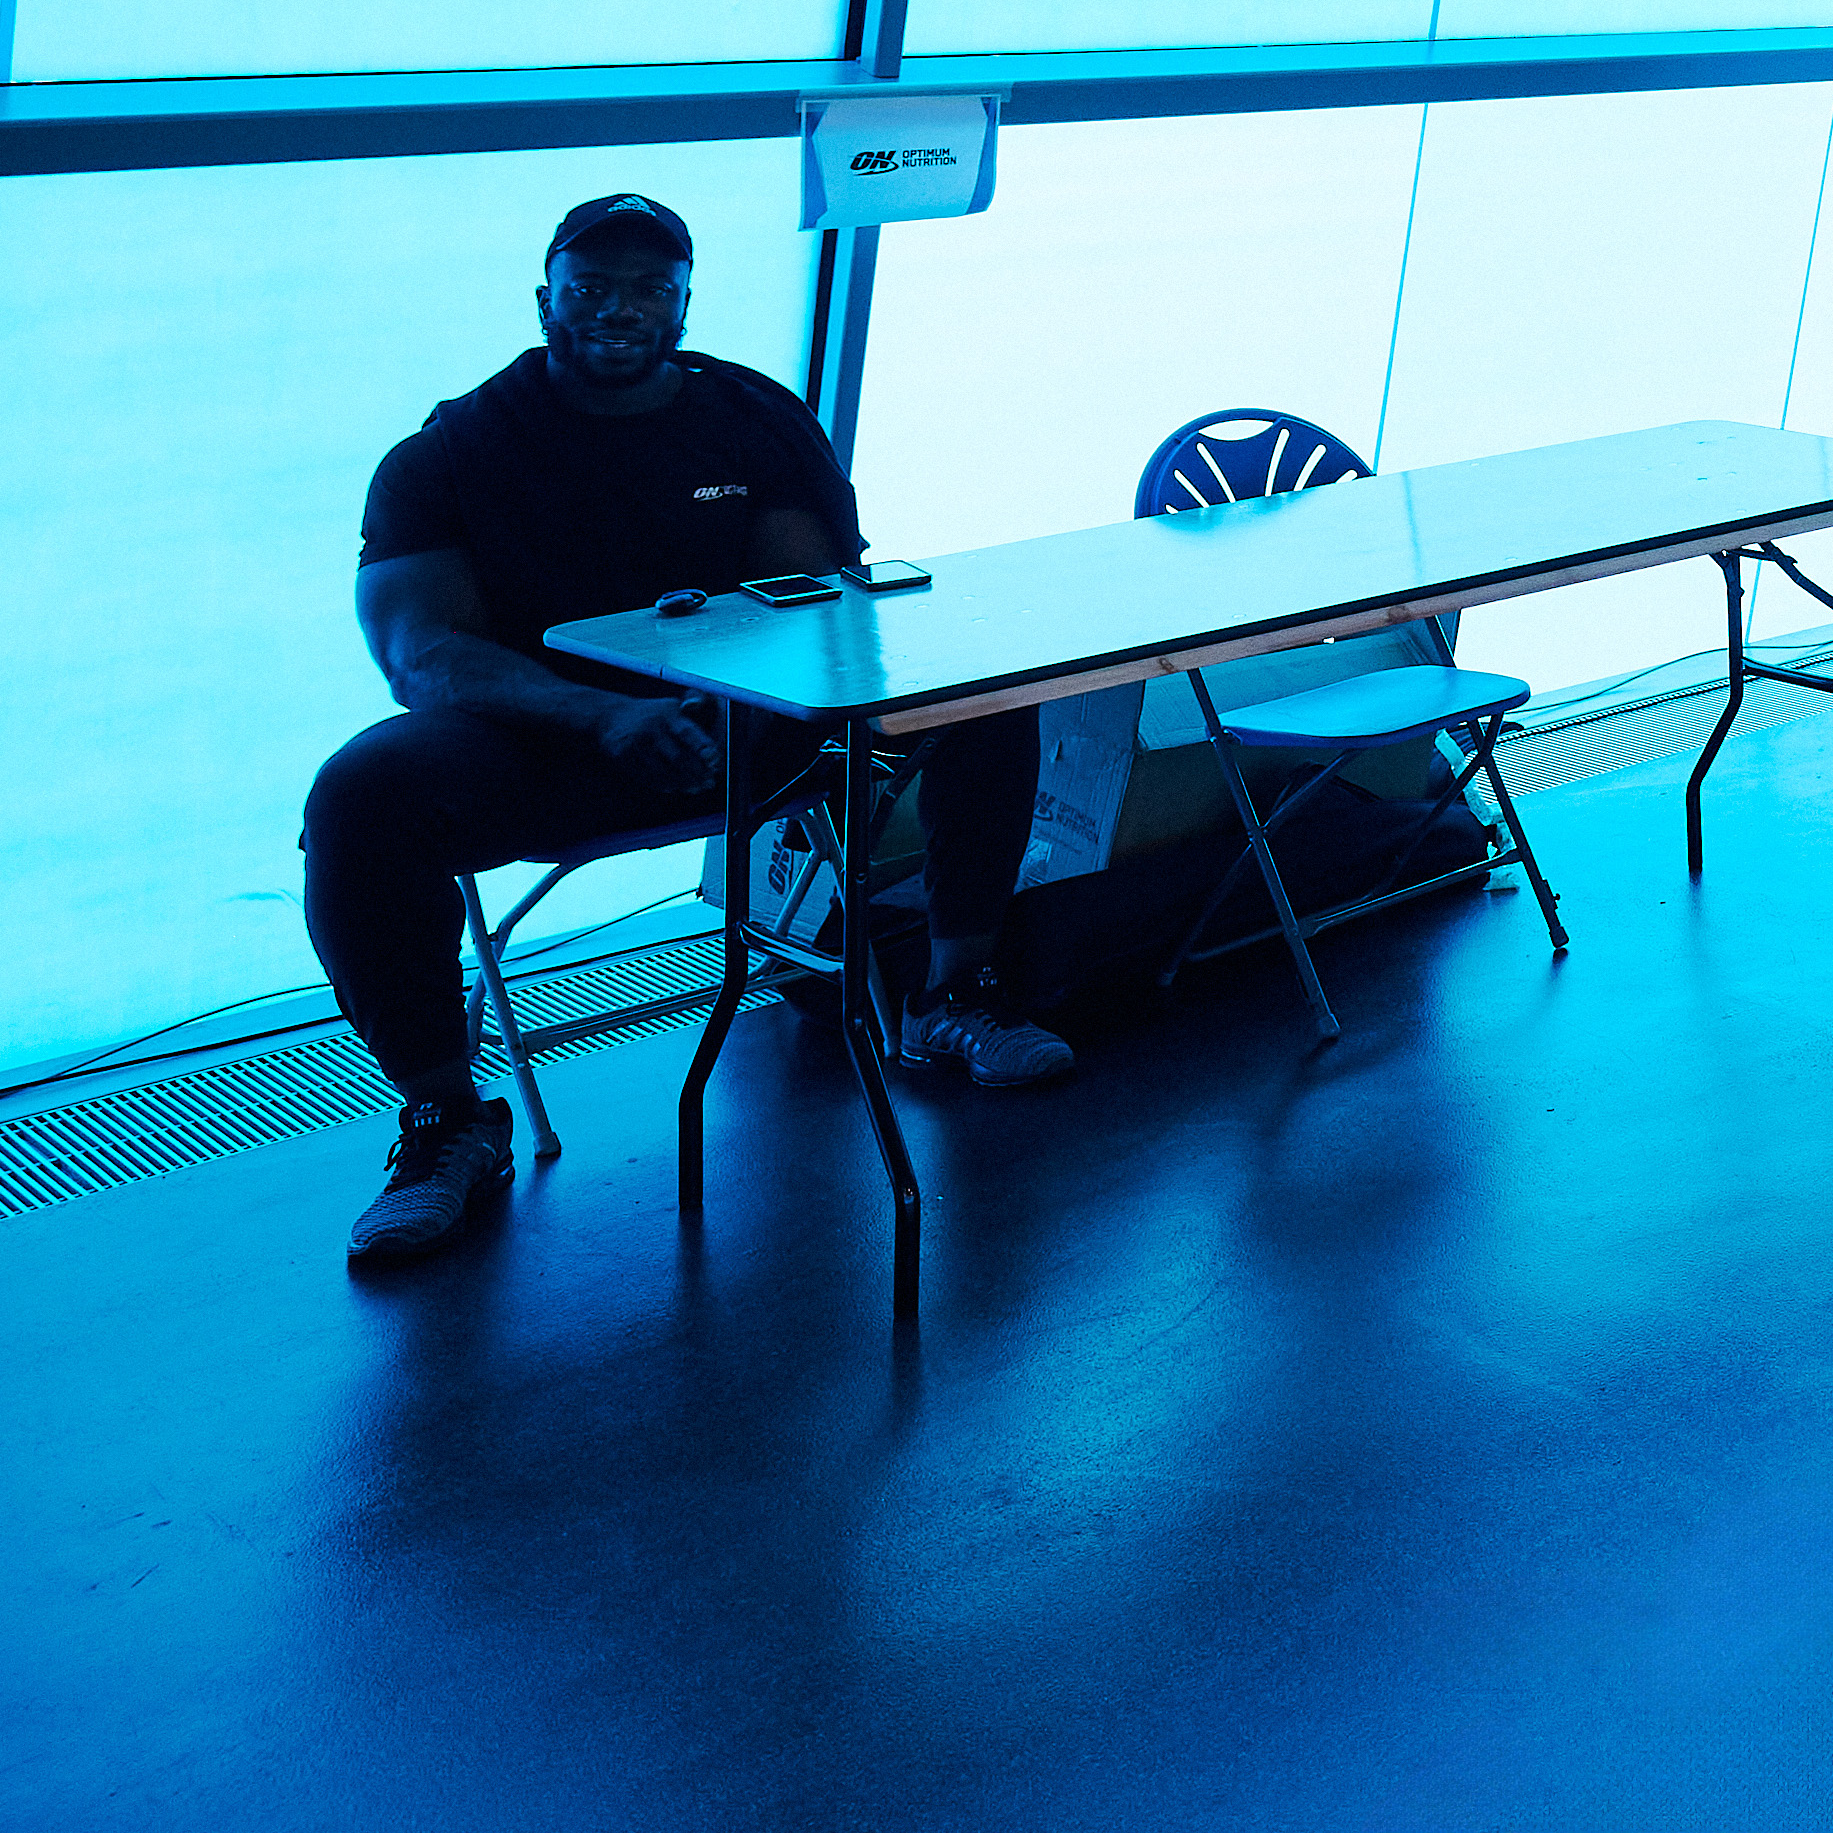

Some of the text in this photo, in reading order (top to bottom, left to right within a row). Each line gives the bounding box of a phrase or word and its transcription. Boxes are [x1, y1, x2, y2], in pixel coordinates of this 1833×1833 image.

[902, 148, 950, 159] OPTIMUM
[850, 150, 899, 176] ON
[902, 157, 957, 168] NUTRITION
